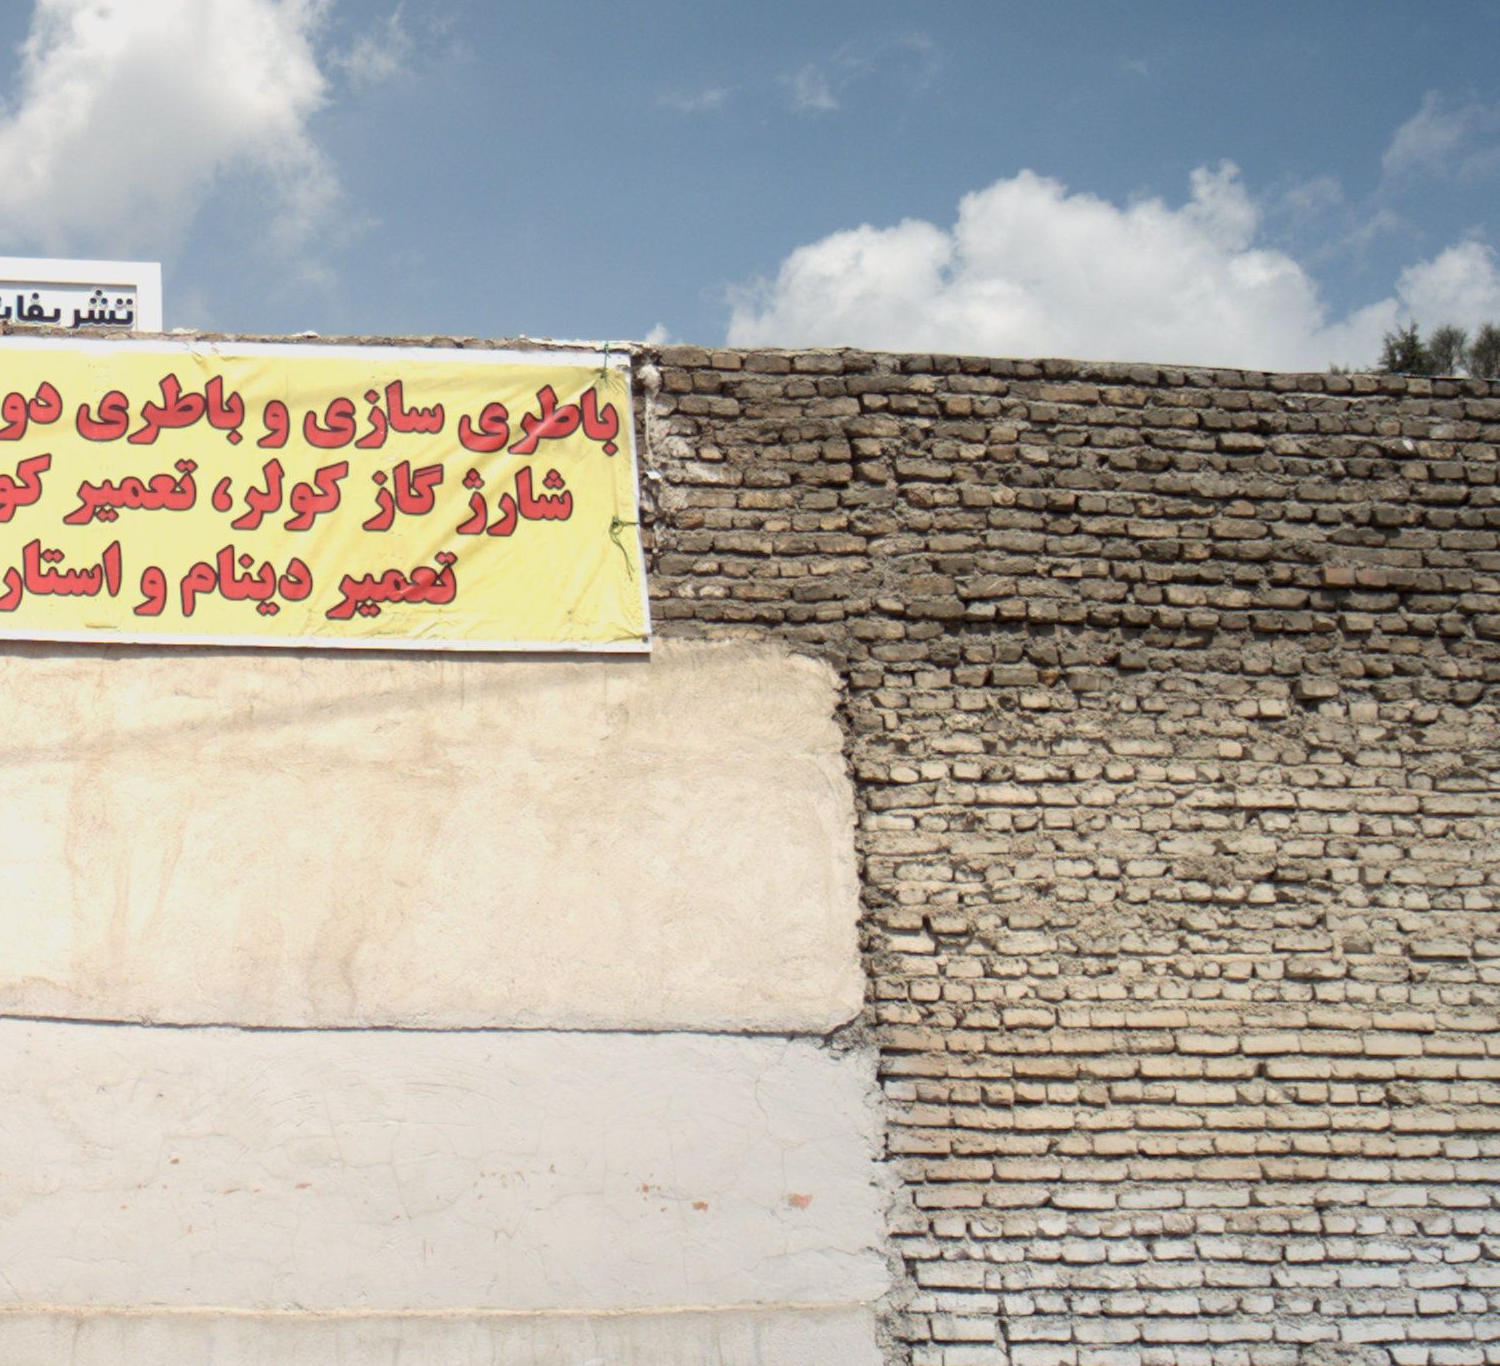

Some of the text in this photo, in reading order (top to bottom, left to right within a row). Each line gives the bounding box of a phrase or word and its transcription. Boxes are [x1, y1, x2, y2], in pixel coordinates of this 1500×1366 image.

[76, 373, 245, 445] باطری
[257, 400, 290, 449] و
[303, 380, 445, 449] سازی
[459, 385, 619, 456] باطری
[63, 459, 198, 524] تعمیر
[362, 460, 444, 531] گاز
[456, 466, 573, 536] شارژ
[133, 566, 168, 616] و
[180, 544, 313, 617] دینام
[326, 551, 457, 620] تعمیر
